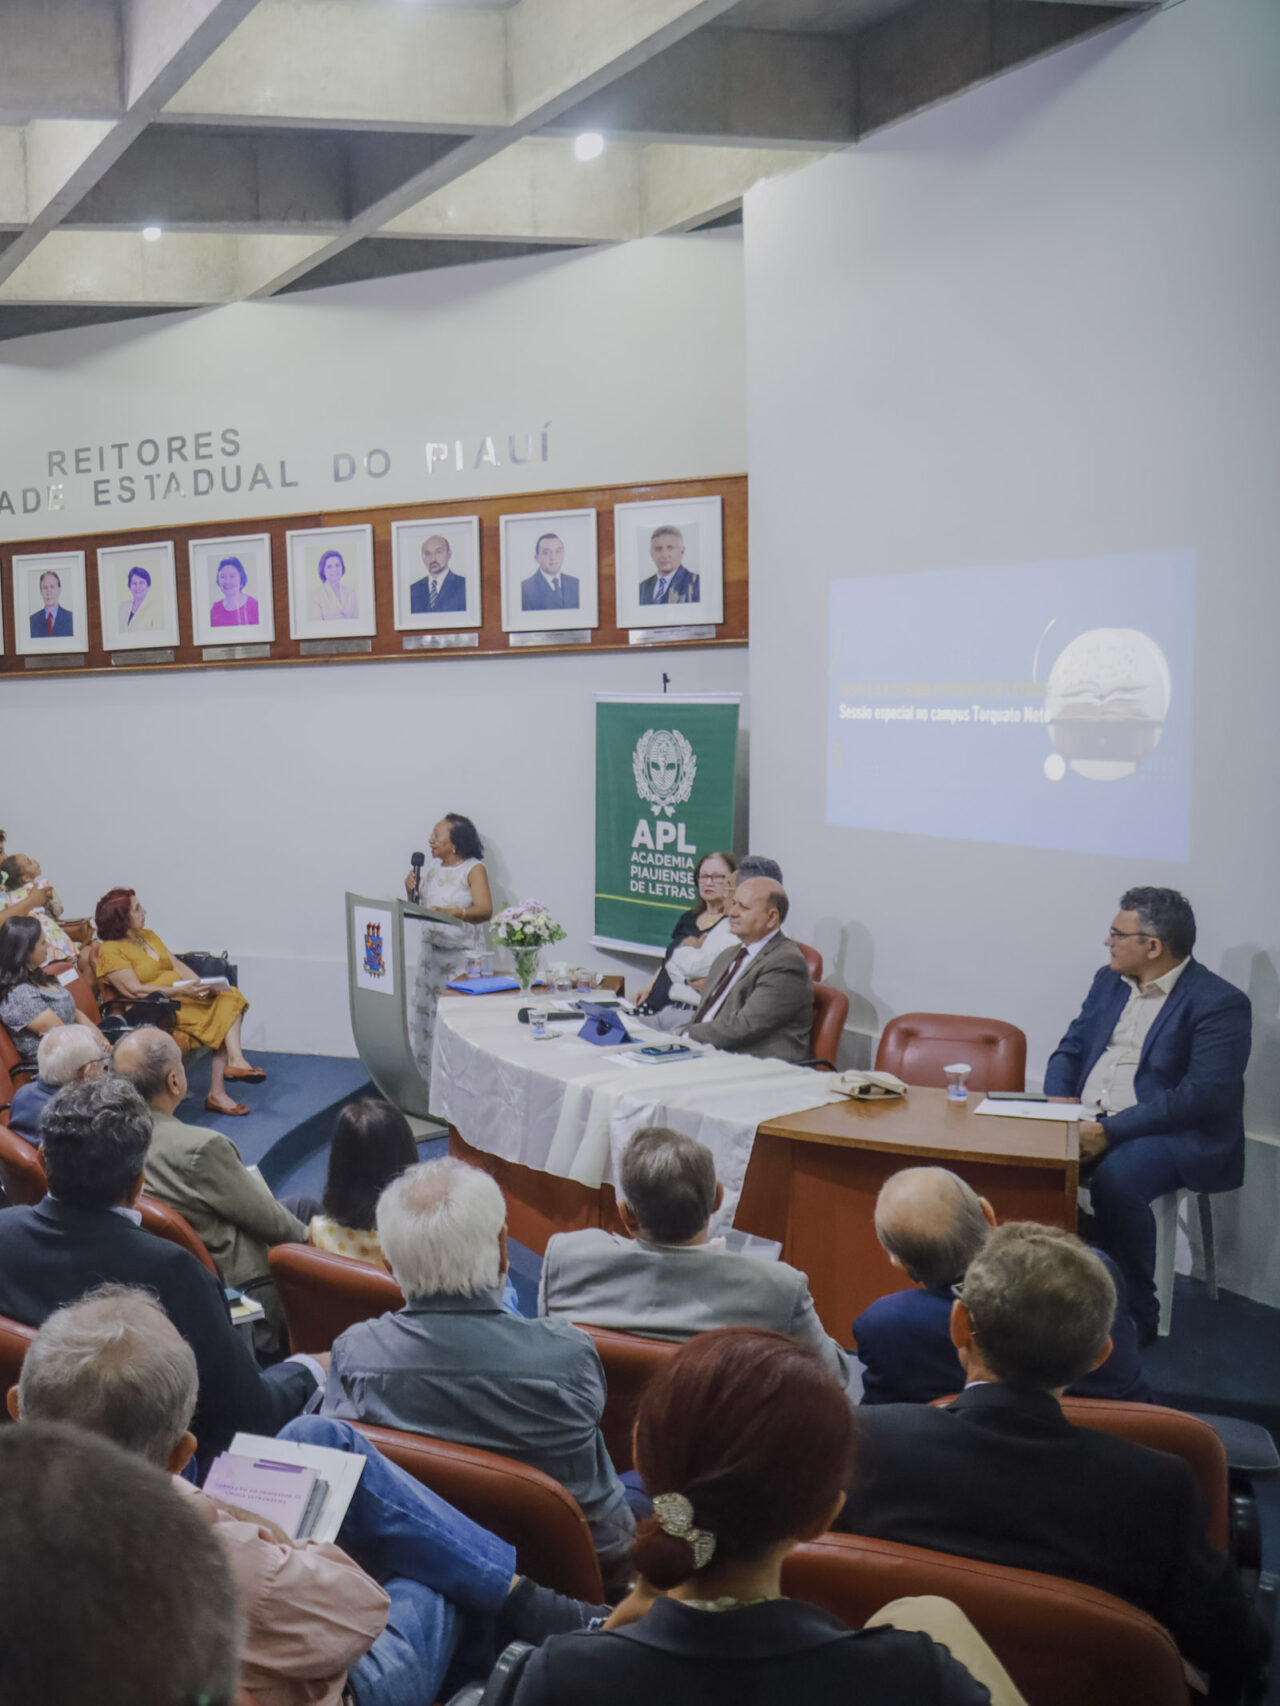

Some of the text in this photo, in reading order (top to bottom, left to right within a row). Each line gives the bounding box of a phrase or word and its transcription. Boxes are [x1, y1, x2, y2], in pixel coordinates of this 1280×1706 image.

[47, 428, 242, 478] REITORES
[93, 460, 300, 507] ESTADUAL
[332, 448, 392, 484] DO
[425, 420, 553, 473] PIAUÍ
[839, 704, 872, 720] Sessão
[874, 706, 915, 724] especial
[916, 707, 929, 720] no
[930, 708, 970, 725] campus
[973, 706, 1021, 725] Torquato
[631, 819, 697, 854] APL
[631, 851, 695, 869] ACADEMIA
[630, 865, 696, 885] PIAUIENSE
[630, 880, 696, 900] DE LETRAS
